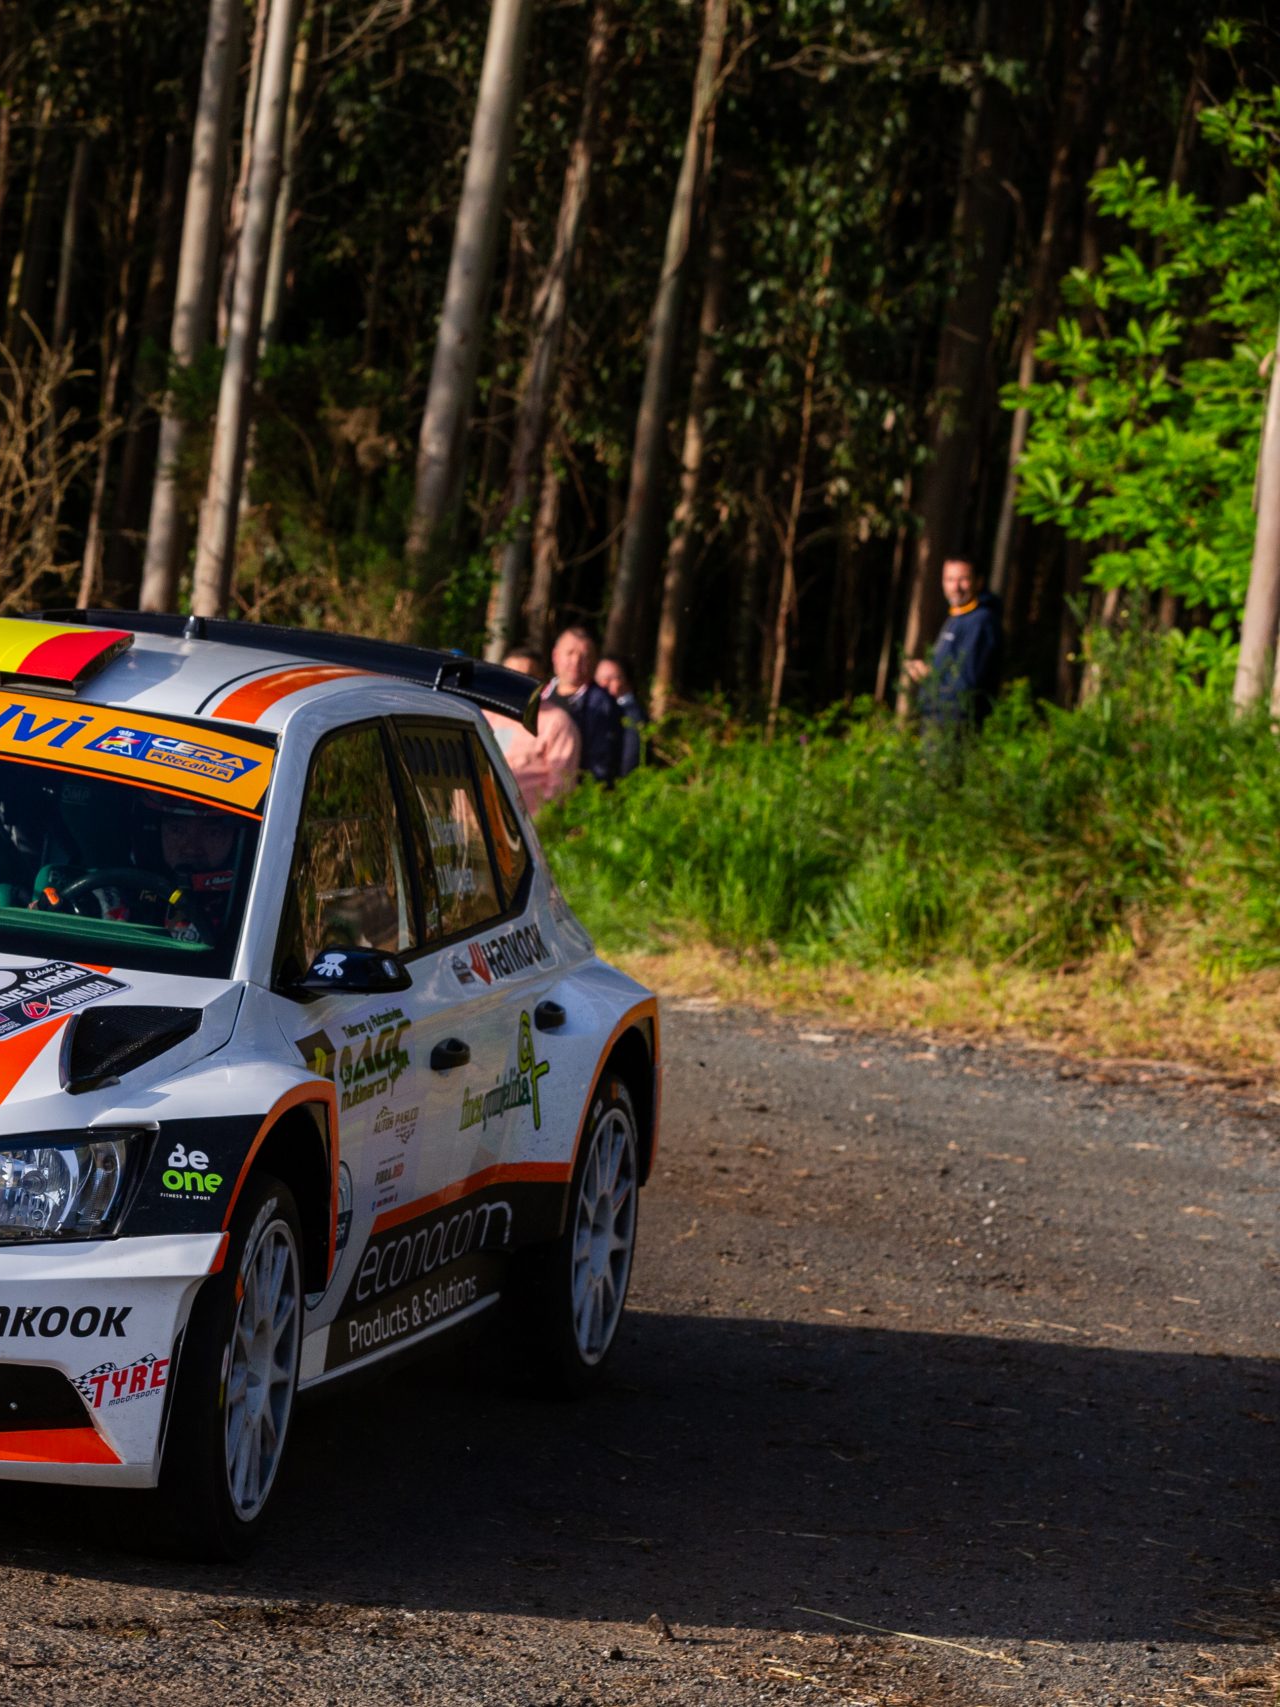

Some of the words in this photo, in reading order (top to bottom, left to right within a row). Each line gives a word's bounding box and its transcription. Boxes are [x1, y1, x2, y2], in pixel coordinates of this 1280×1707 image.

[151, 737, 245, 771] CERA
[162, 753, 218, 775] Recalvi
[20, 967, 87, 997] NARÓN
[25, 967, 55, 979] Cidade
[162, 1169, 223, 1193] one
[356, 1201, 513, 1301] econocom
[349, 1303, 409, 1353] Products
[411, 1295, 422, 1327] &
[424, 1275, 477, 1322] Solutions
[89, 1358, 170, 1409] TYRE
[108, 1389, 161, 1407] motorsport
